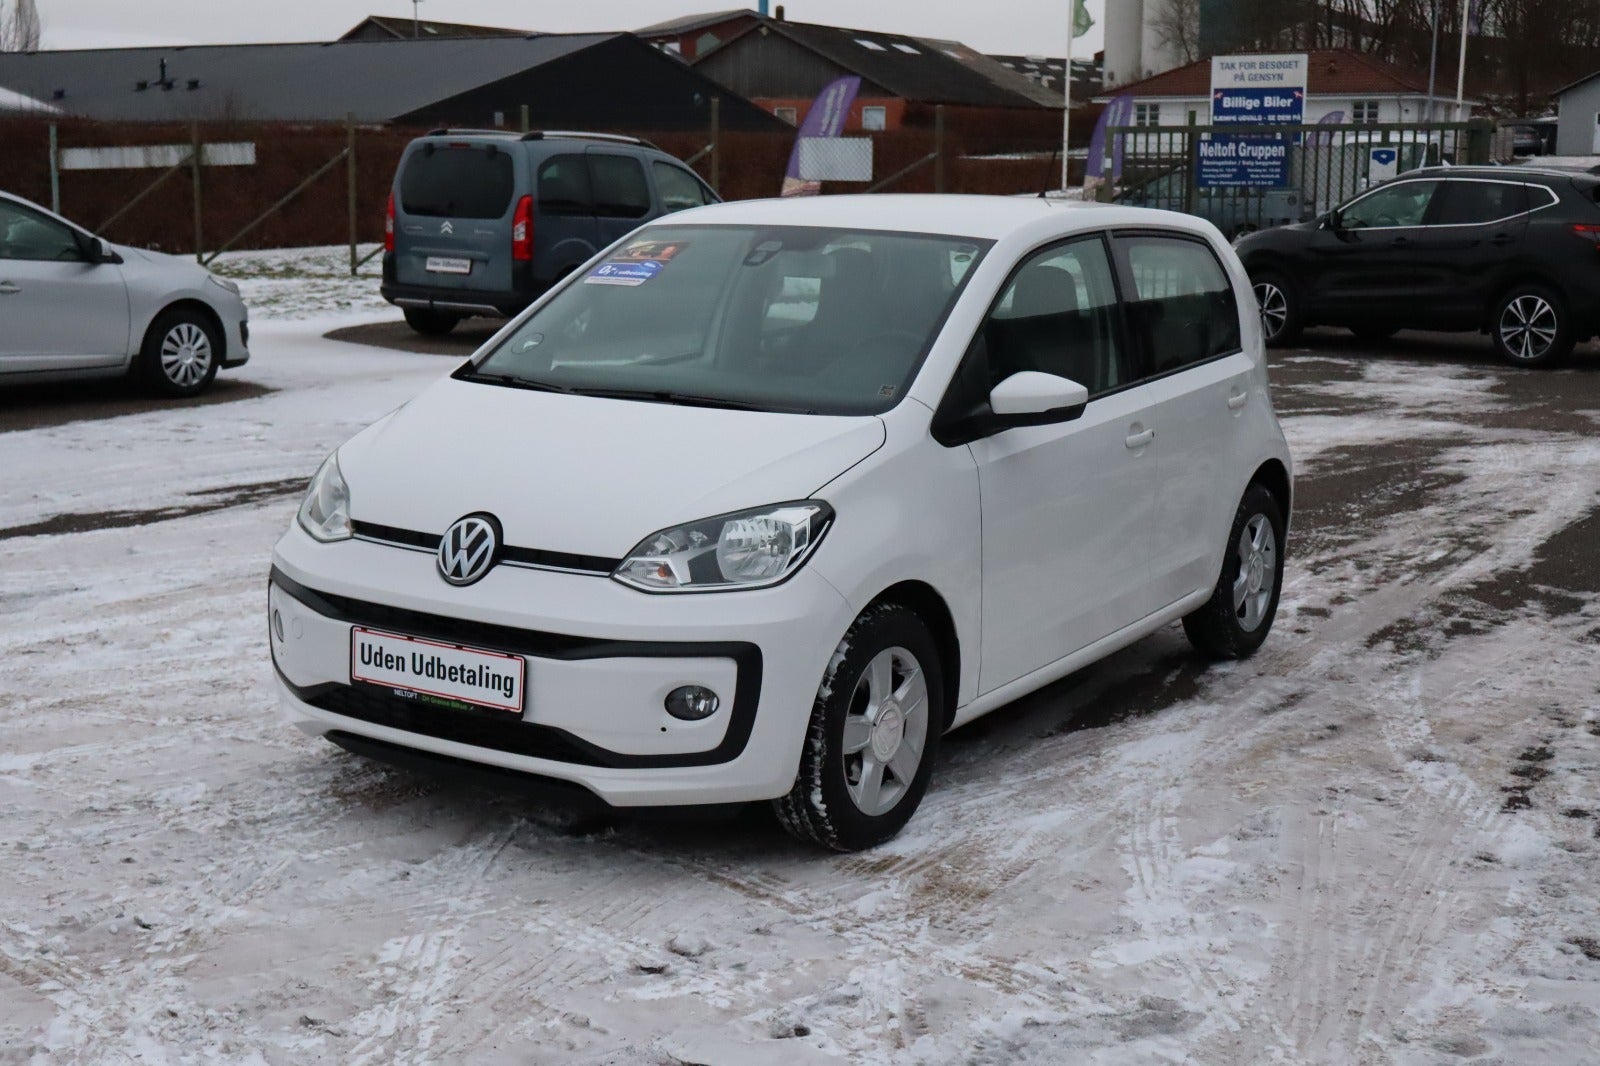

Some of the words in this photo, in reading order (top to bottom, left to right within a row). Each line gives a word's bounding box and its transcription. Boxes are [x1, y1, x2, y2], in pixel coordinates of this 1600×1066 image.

[1219, 62, 1236, 70] TAK
[1239, 61, 1256, 70] FOR
[1258, 60, 1300, 70] BESØGET
[1233, 72, 1245, 82] PÅ
[1248, 73, 1284, 82] GENSYN
[1222, 96, 1260, 110] Billige
[1263, 95, 1293, 108] Biler
[1199, 142, 1236, 157] Neltoft
[1238, 144, 1285, 160] Gruppen
[438, 517, 495, 580] VW
[360, 642, 405, 673] Uden
[411, 652, 514, 699] Udbetaling
[393, 688, 418, 699] NELTOFT
